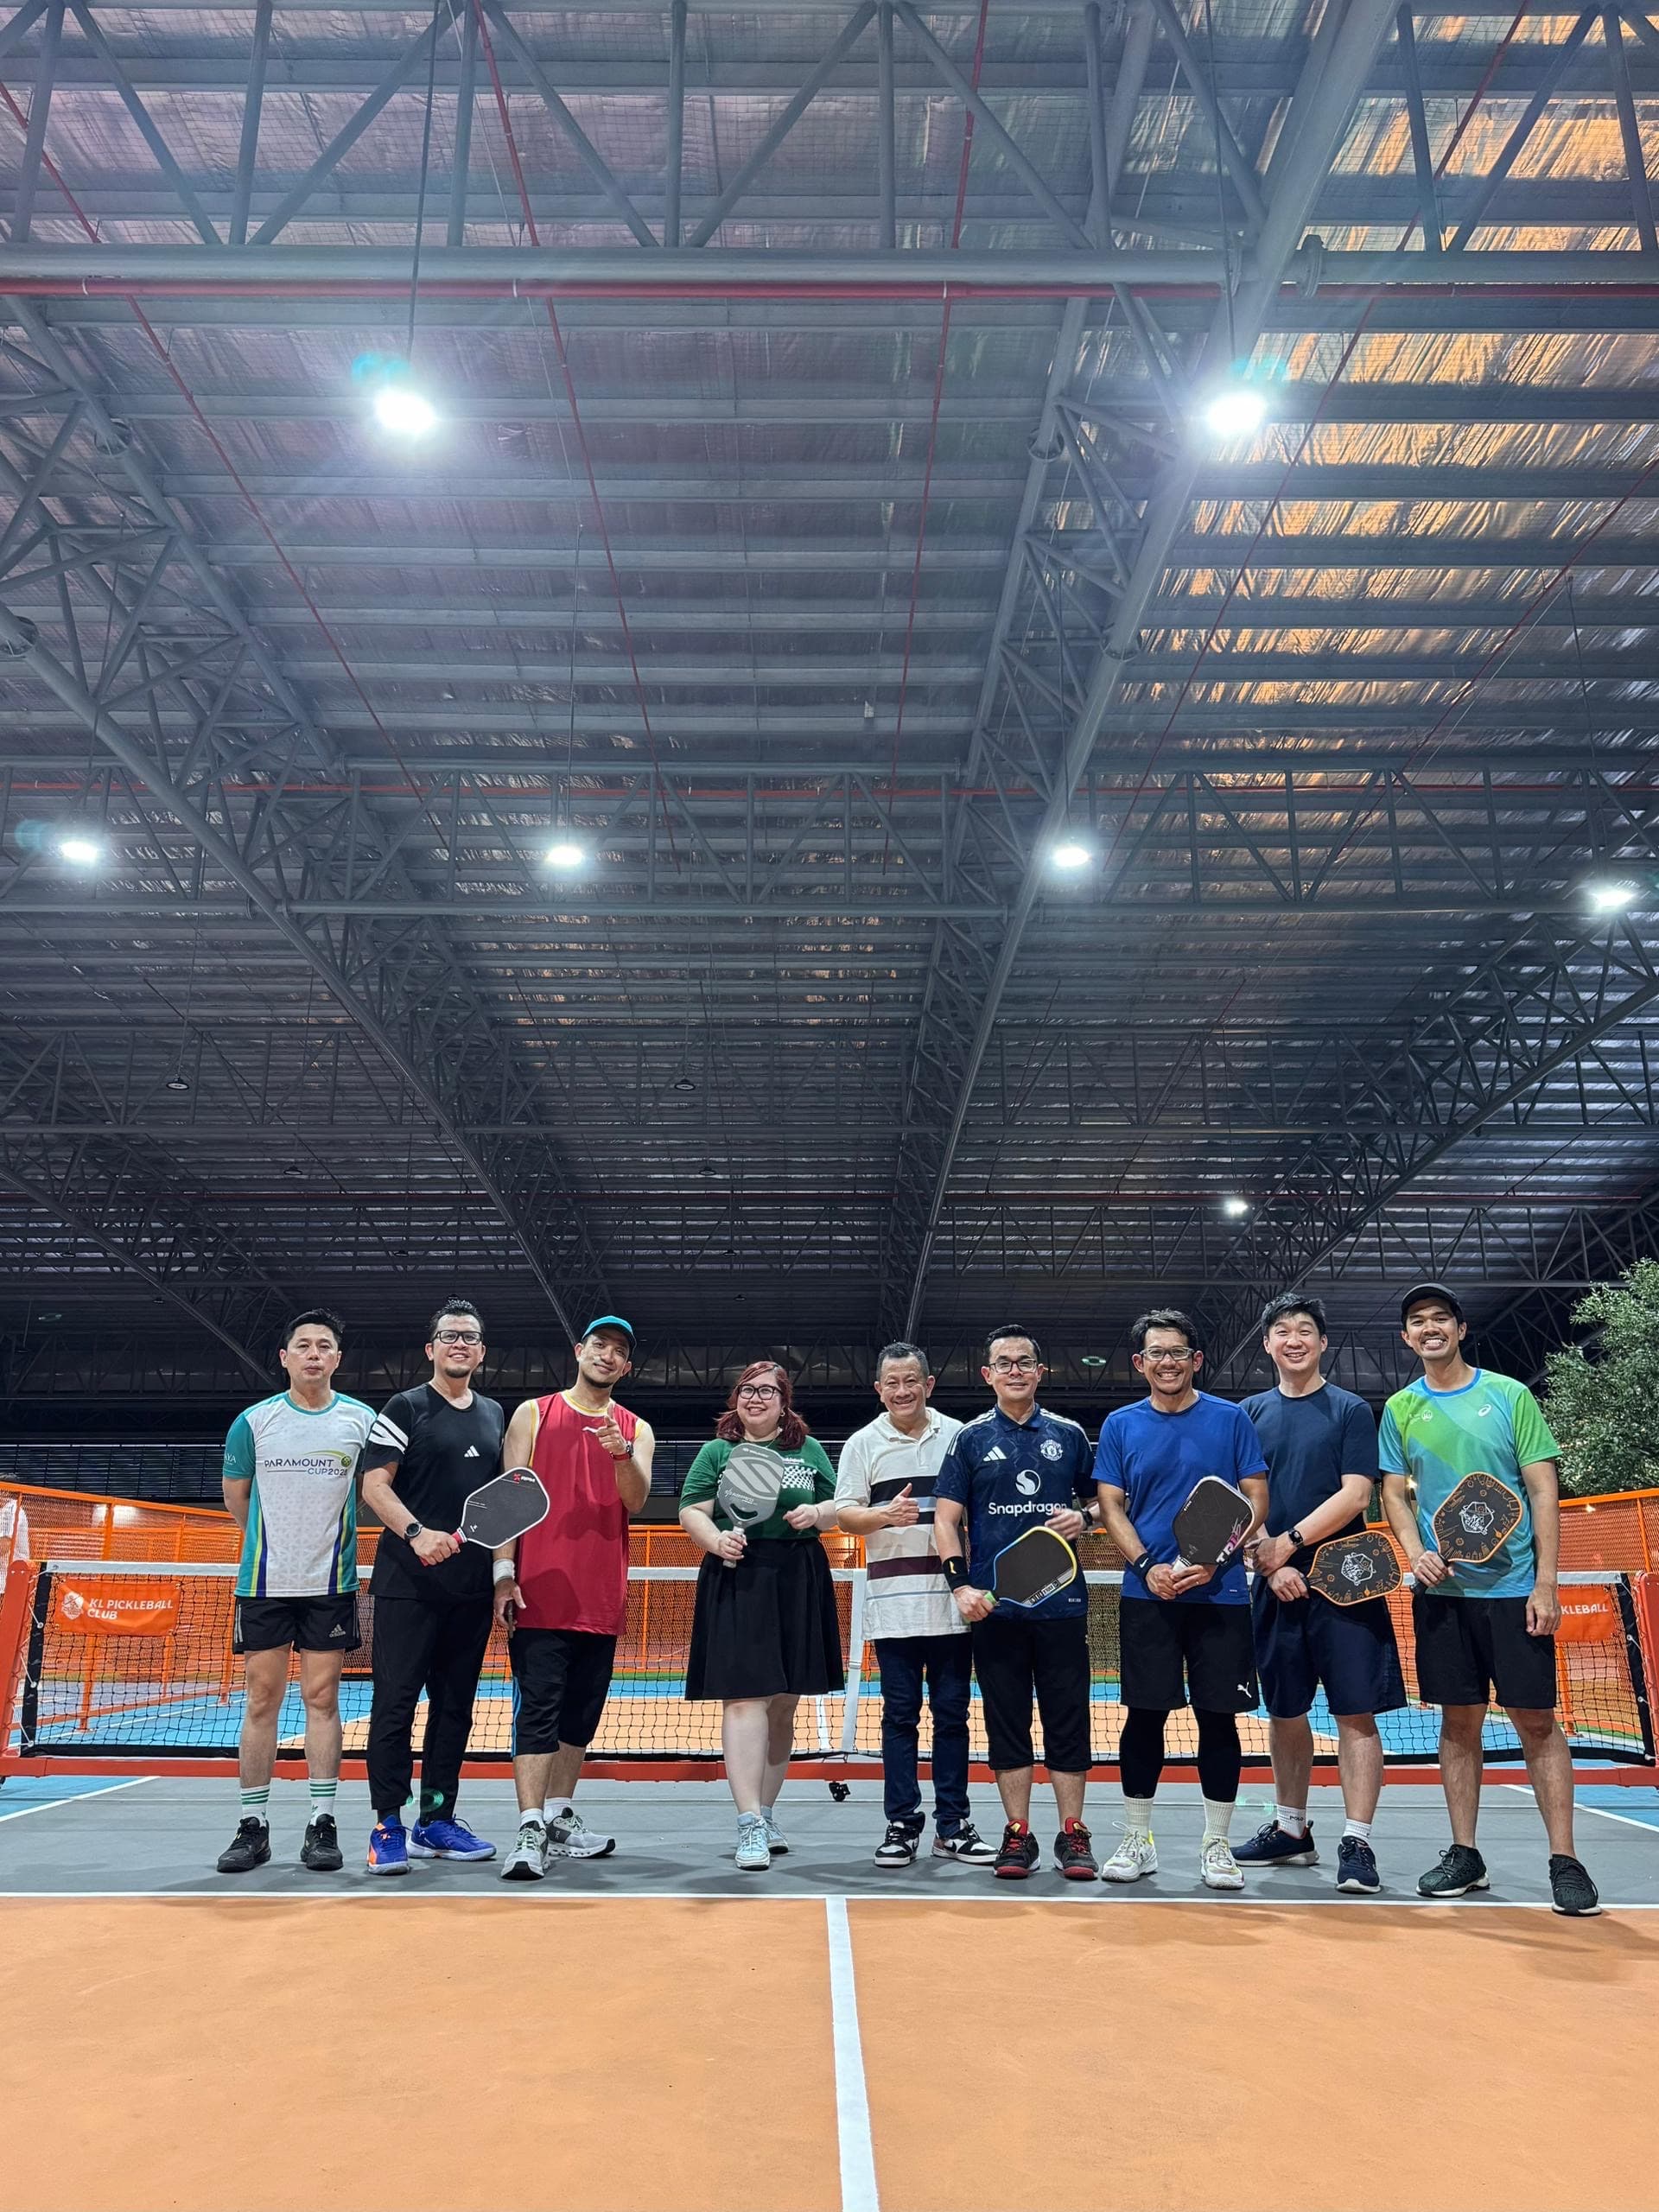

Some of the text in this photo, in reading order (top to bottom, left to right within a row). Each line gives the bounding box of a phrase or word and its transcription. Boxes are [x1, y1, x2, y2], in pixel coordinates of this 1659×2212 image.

[264, 1458, 334, 1468] PARAMOUNT
[89, 1599, 174, 1610] KL PICKLEBALL
[1560, 1603, 1609, 1615] KLEBALL
[87, 1608, 118, 1620] CLUB
